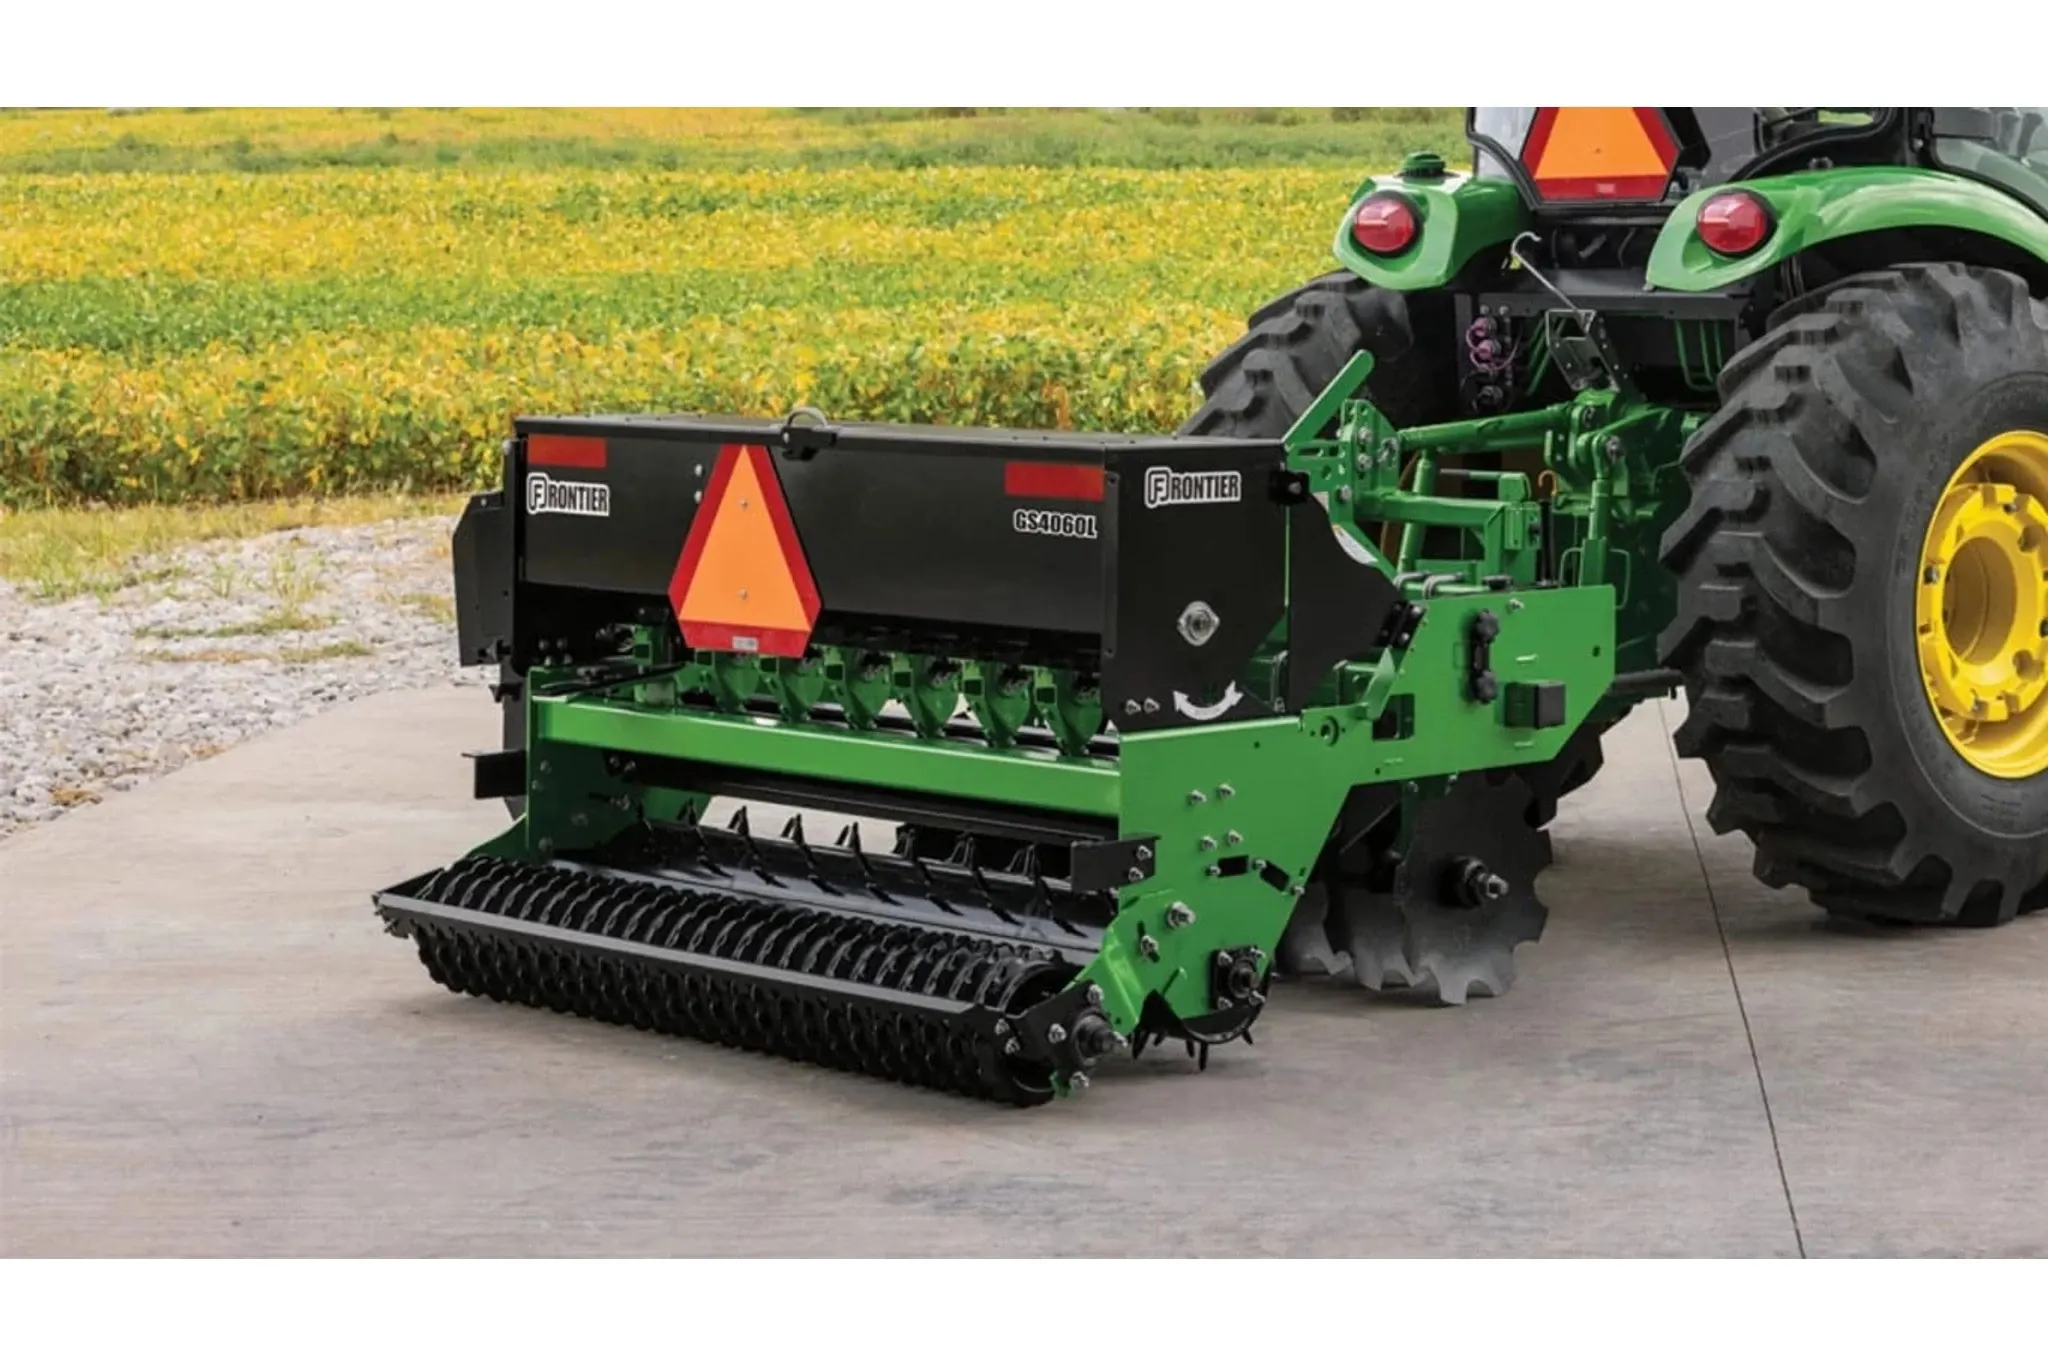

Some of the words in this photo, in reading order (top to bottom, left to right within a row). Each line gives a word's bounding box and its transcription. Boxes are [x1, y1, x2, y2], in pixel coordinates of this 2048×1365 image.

[528, 474, 608, 514] FRONTIER
[1146, 469, 1240, 506] FRONTIER
[1014, 510, 1097, 538] GS4060L
